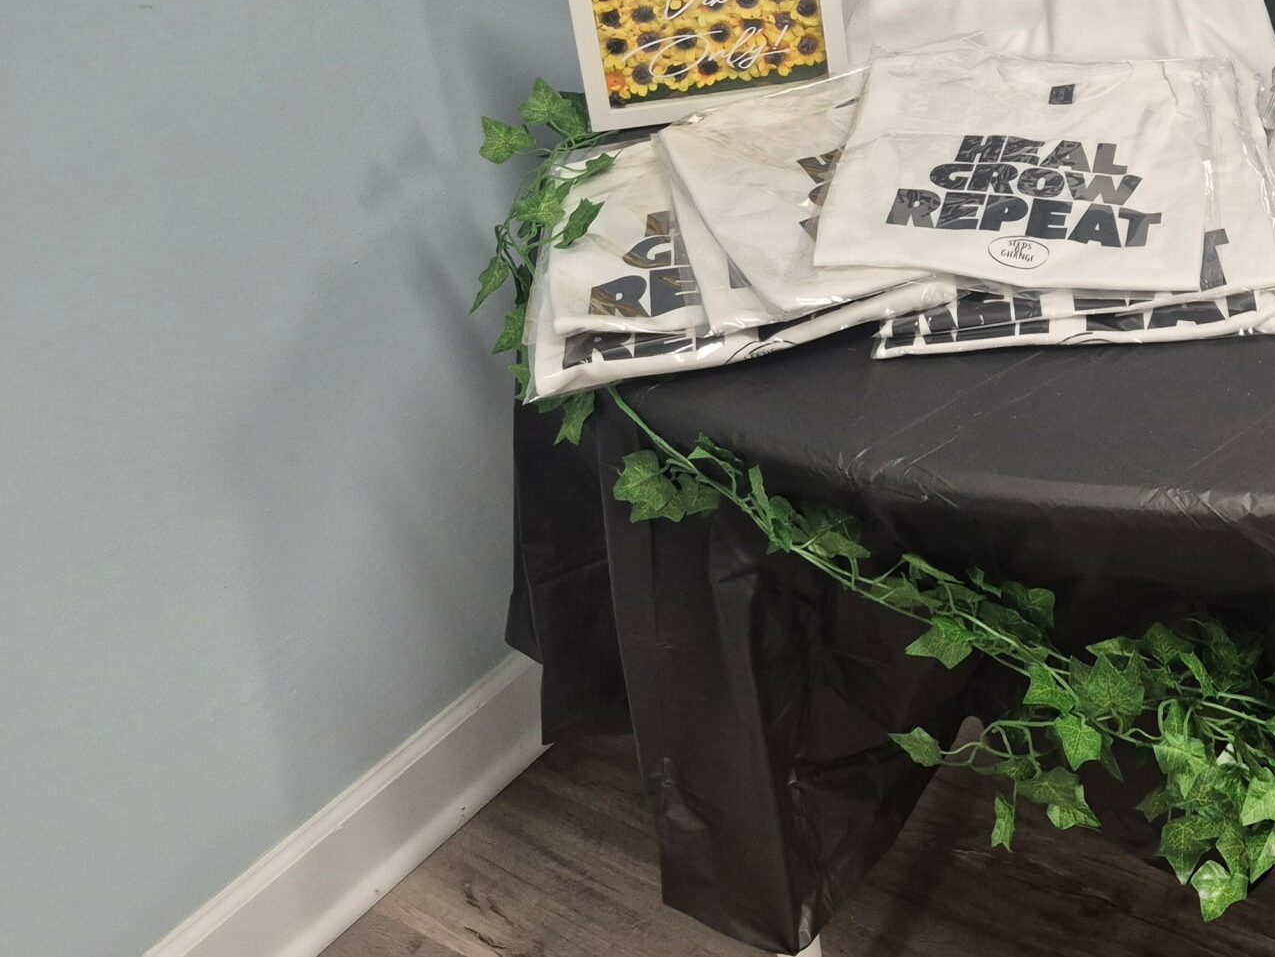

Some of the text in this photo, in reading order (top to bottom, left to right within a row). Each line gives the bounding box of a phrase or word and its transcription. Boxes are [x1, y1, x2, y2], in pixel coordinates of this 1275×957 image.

[622, 25, 791, 78] Only!
[954, 135, 1129, 176] HEAL
[929, 163, 1143, 205] GROW
[885, 188, 1162, 248] REPEAT
